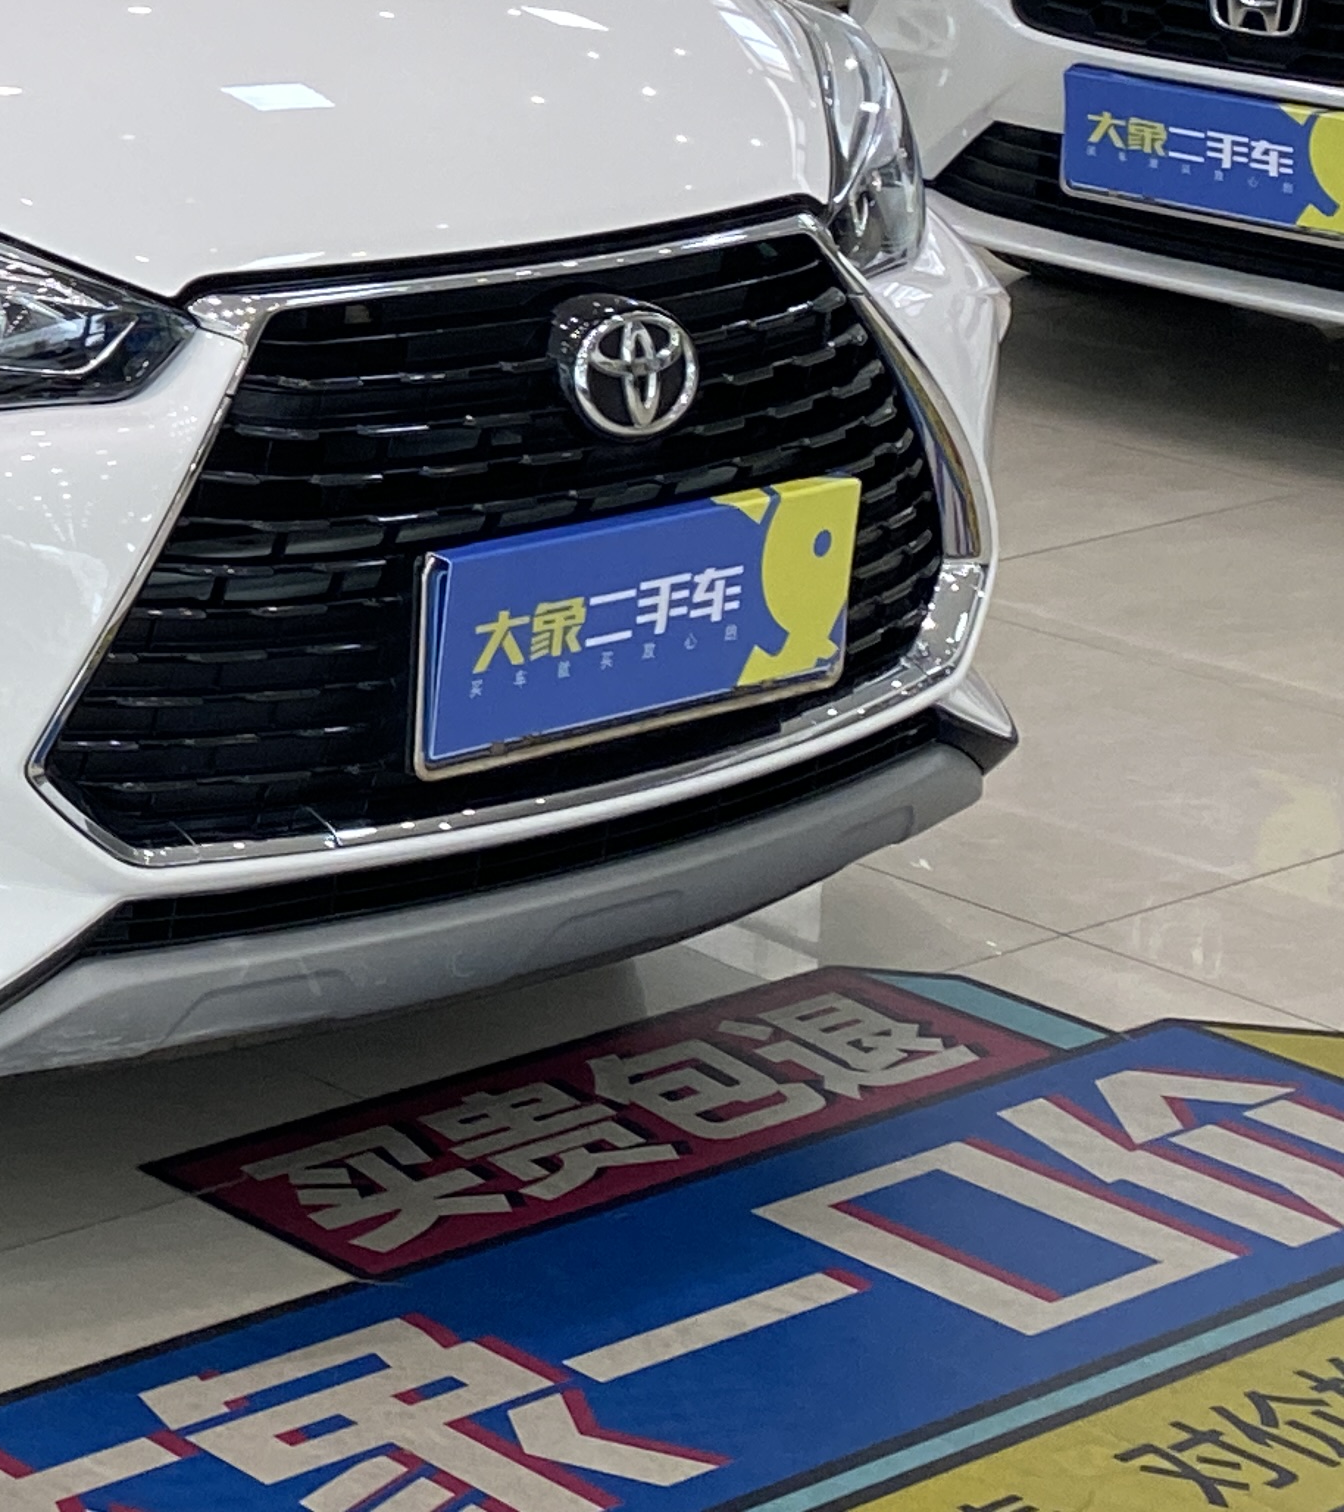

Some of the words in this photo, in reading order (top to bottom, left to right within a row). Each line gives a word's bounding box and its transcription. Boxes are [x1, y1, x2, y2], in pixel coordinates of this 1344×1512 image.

[1087, 111, 1294, 178] 大象二手车
[472, 565, 744, 675] 大象二手车
[241, 991, 982, 1254] 买贵包退
[1113, 1356, 1344, 1508] 对价
